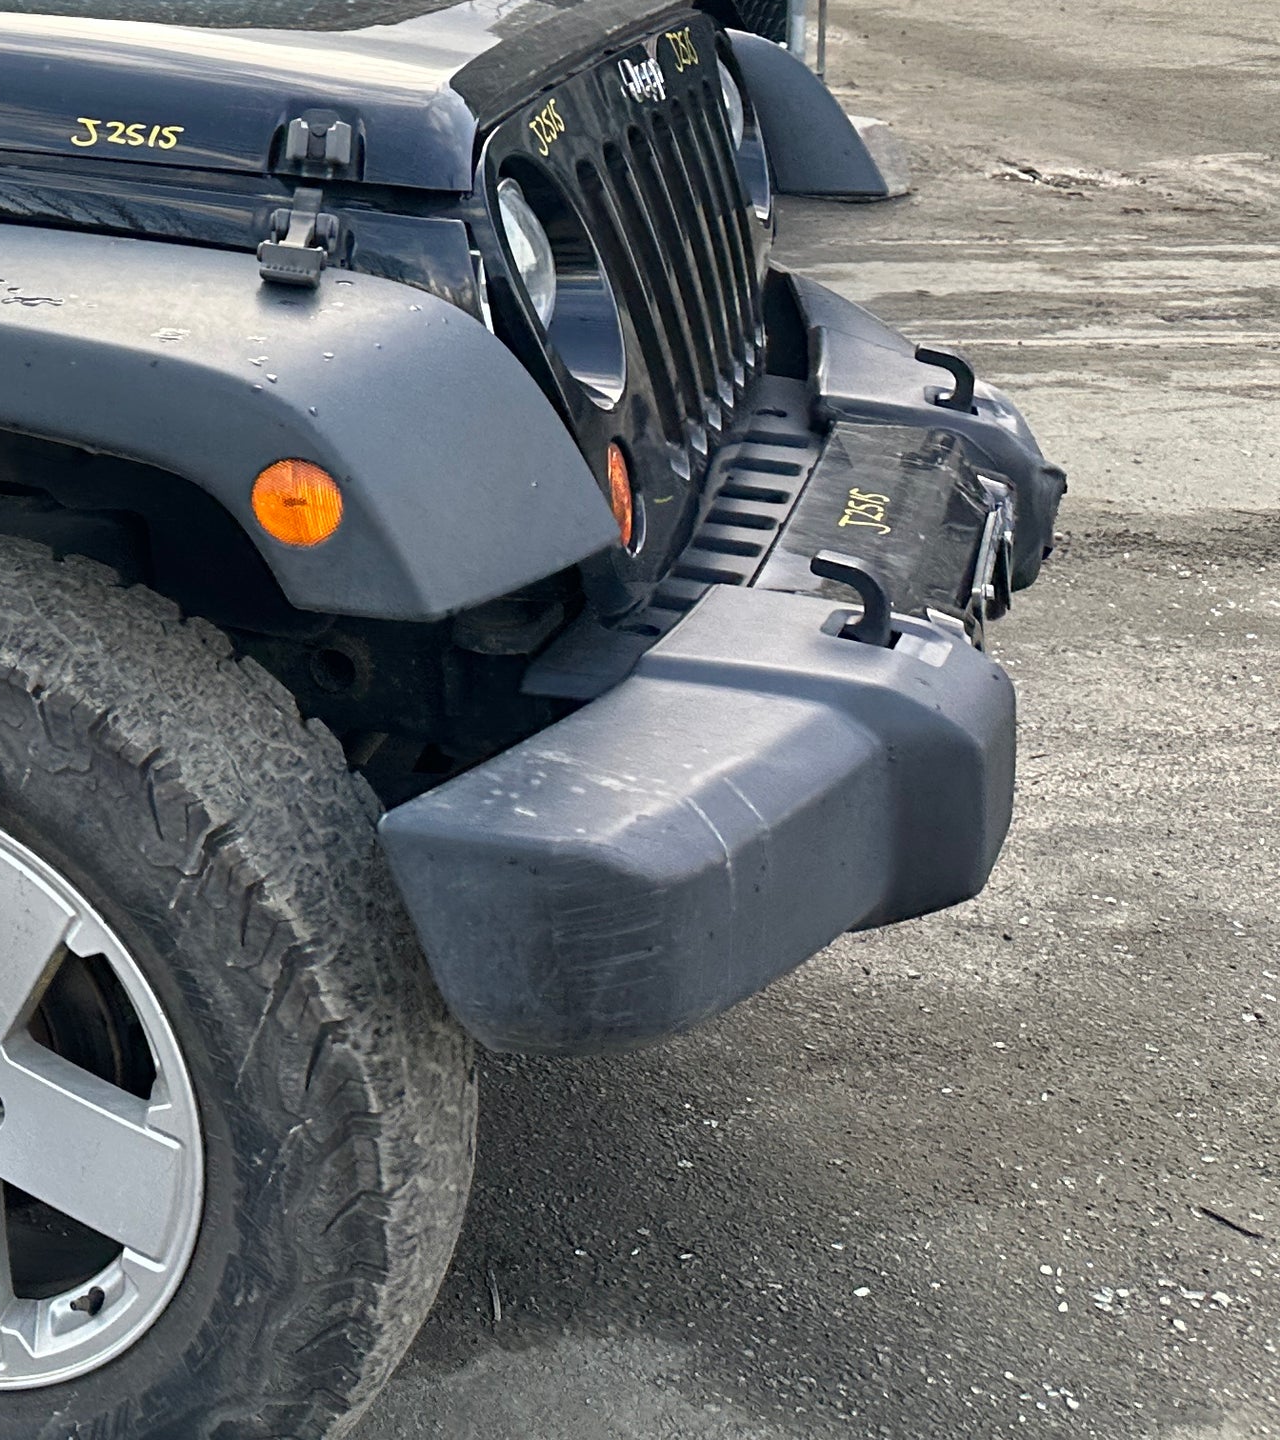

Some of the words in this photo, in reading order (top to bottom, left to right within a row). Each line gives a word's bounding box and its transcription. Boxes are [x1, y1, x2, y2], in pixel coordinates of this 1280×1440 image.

[618, 58, 667, 103] Jeep
[71, 116, 184, 152] J2515
[529, 98, 565, 156] J2515
[838, 487, 891, 535] J2515
